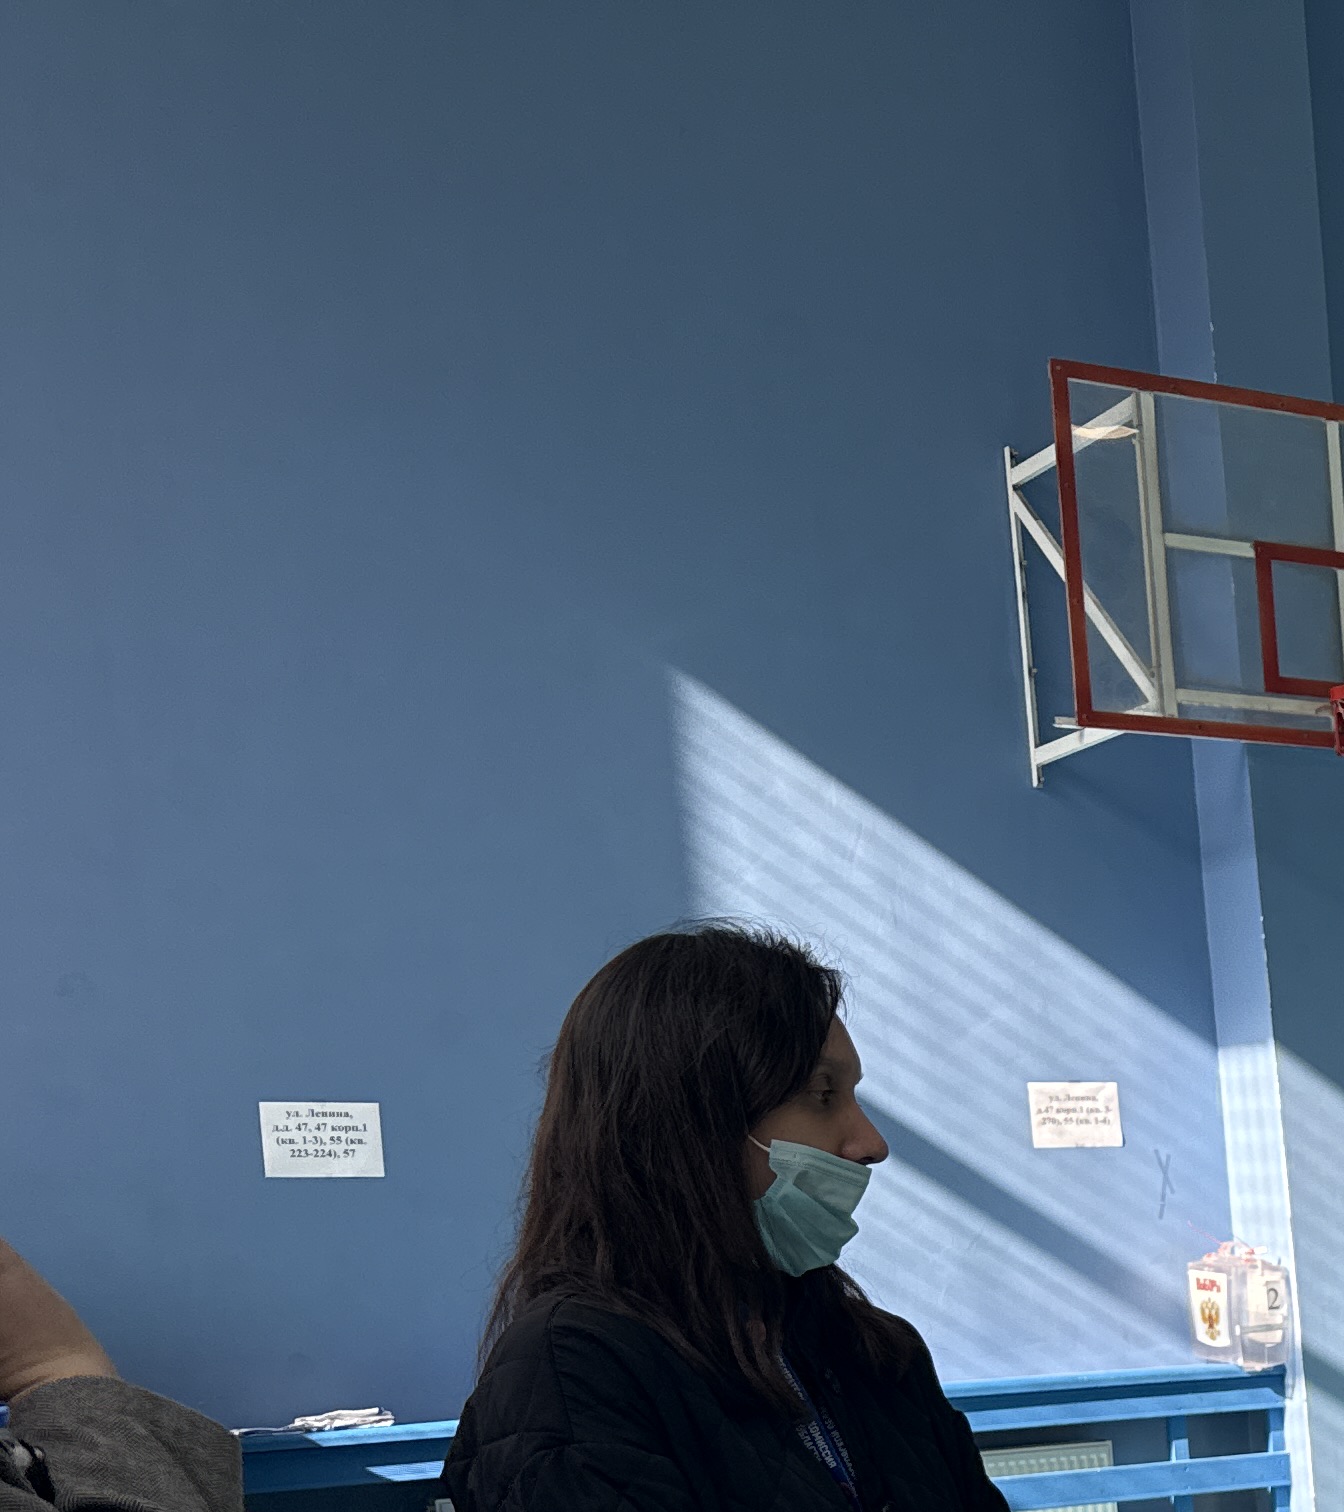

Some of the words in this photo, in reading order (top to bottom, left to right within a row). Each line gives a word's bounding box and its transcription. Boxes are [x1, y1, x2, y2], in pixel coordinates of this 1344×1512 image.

[286, 1110, 303, 1119] ул.
[305, 1109, 353, 1119] Ленина,
[295, 1123, 312, 1132] 47,
[315, 1123, 327, 1132] 47
[331, 1123, 368, 1134] корп.1
[276, 1136, 299, 1146] (кв.
[329, 1136, 343, 1145] 55
[345, 1136, 367, 1146] (кв.
[289, 1148, 340, 1159] 223-224),
[343, 1148, 356, 1158] 57
[1267, 1287, 1281, 1311] 2
